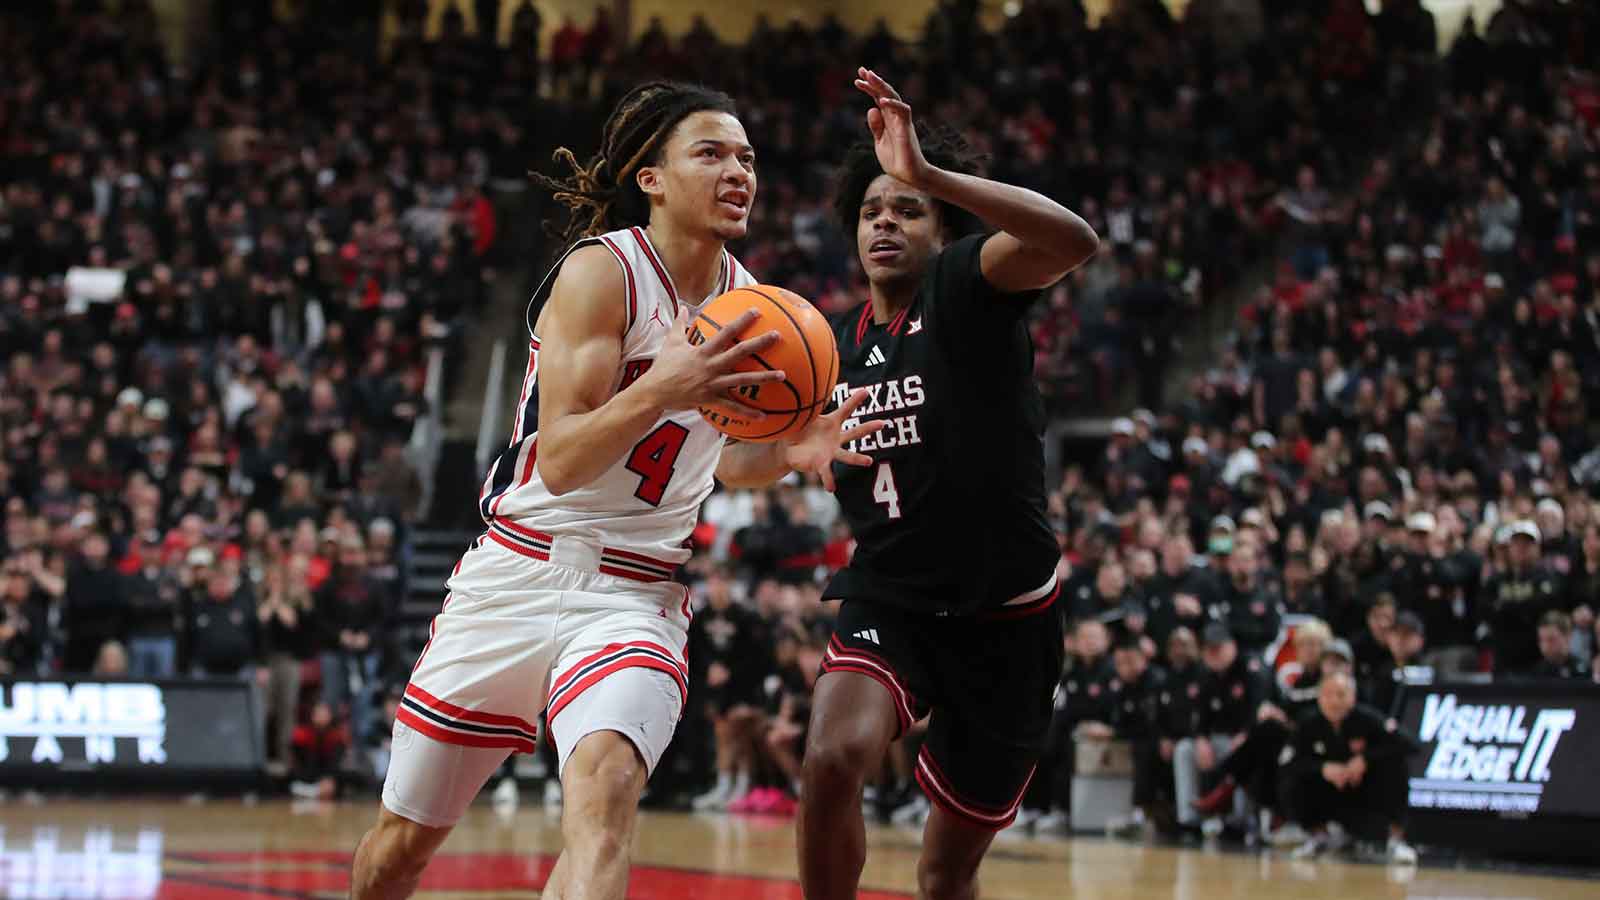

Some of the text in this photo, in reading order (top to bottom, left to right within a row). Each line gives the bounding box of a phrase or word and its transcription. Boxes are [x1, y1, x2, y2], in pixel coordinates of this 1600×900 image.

[624, 419, 690, 508] 4
[873, 462, 902, 519] 4
[1419, 693, 1529, 743] VISUAL
[1424, 741, 1520, 783] EDGE
